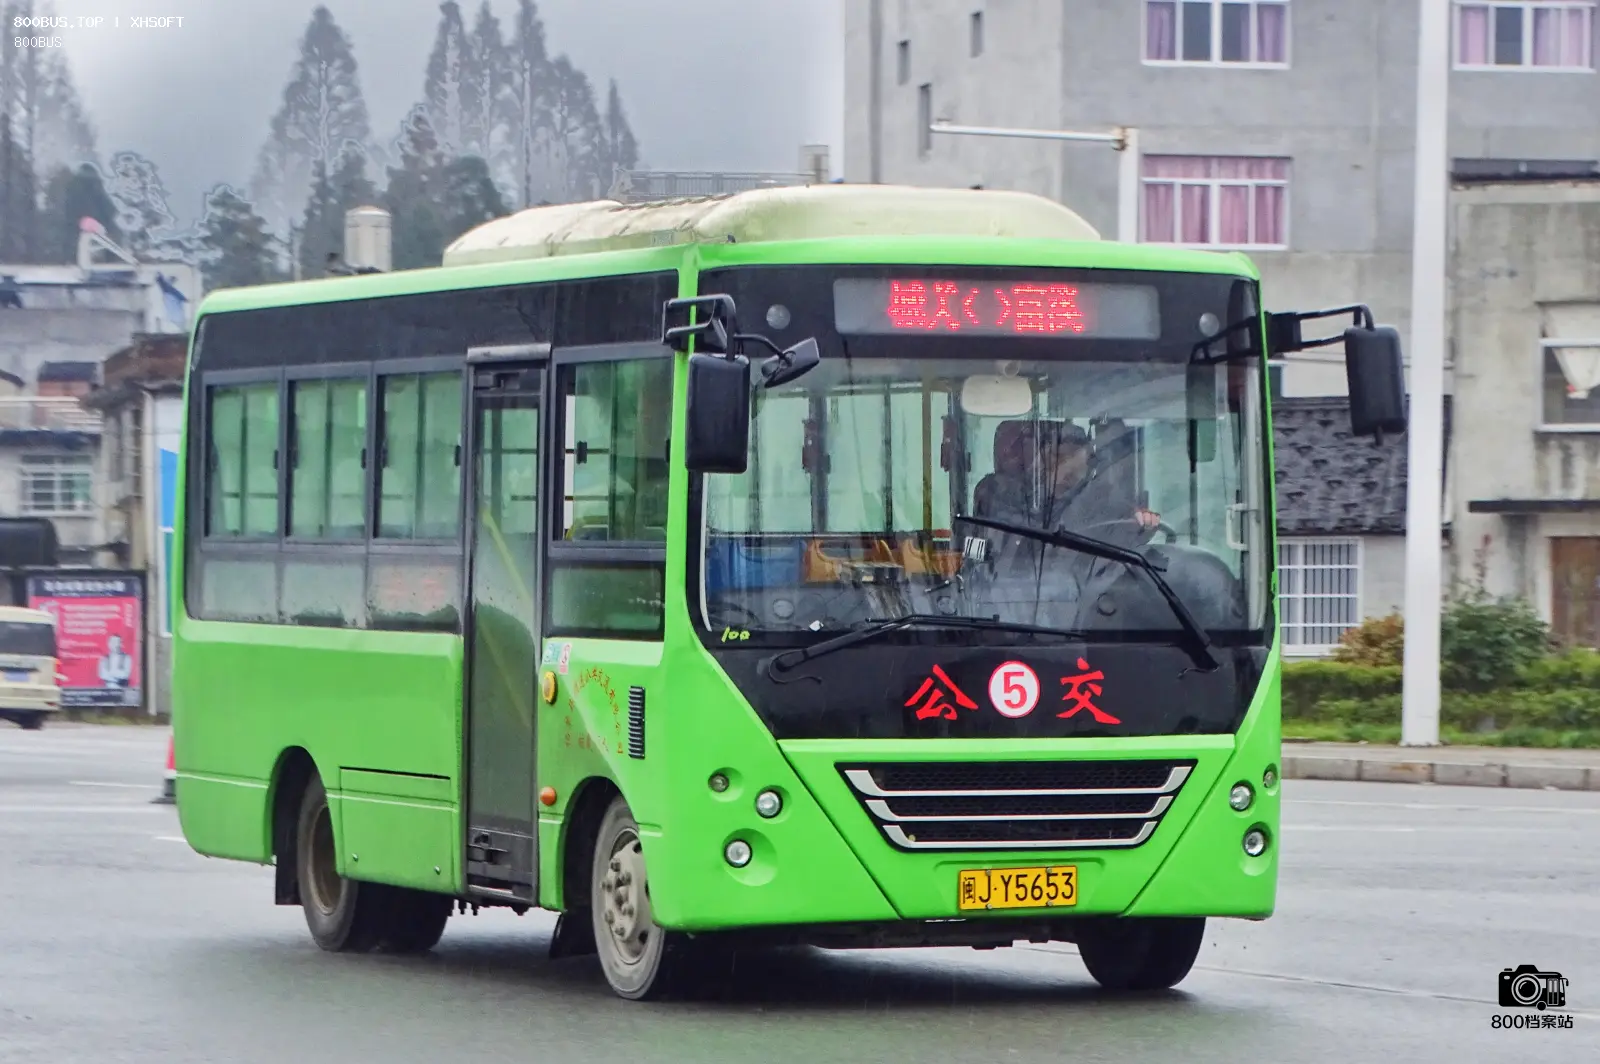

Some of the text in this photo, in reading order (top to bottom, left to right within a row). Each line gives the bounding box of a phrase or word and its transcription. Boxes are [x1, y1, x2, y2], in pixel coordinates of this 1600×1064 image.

[904, 656, 1122, 725] 公 5 交
